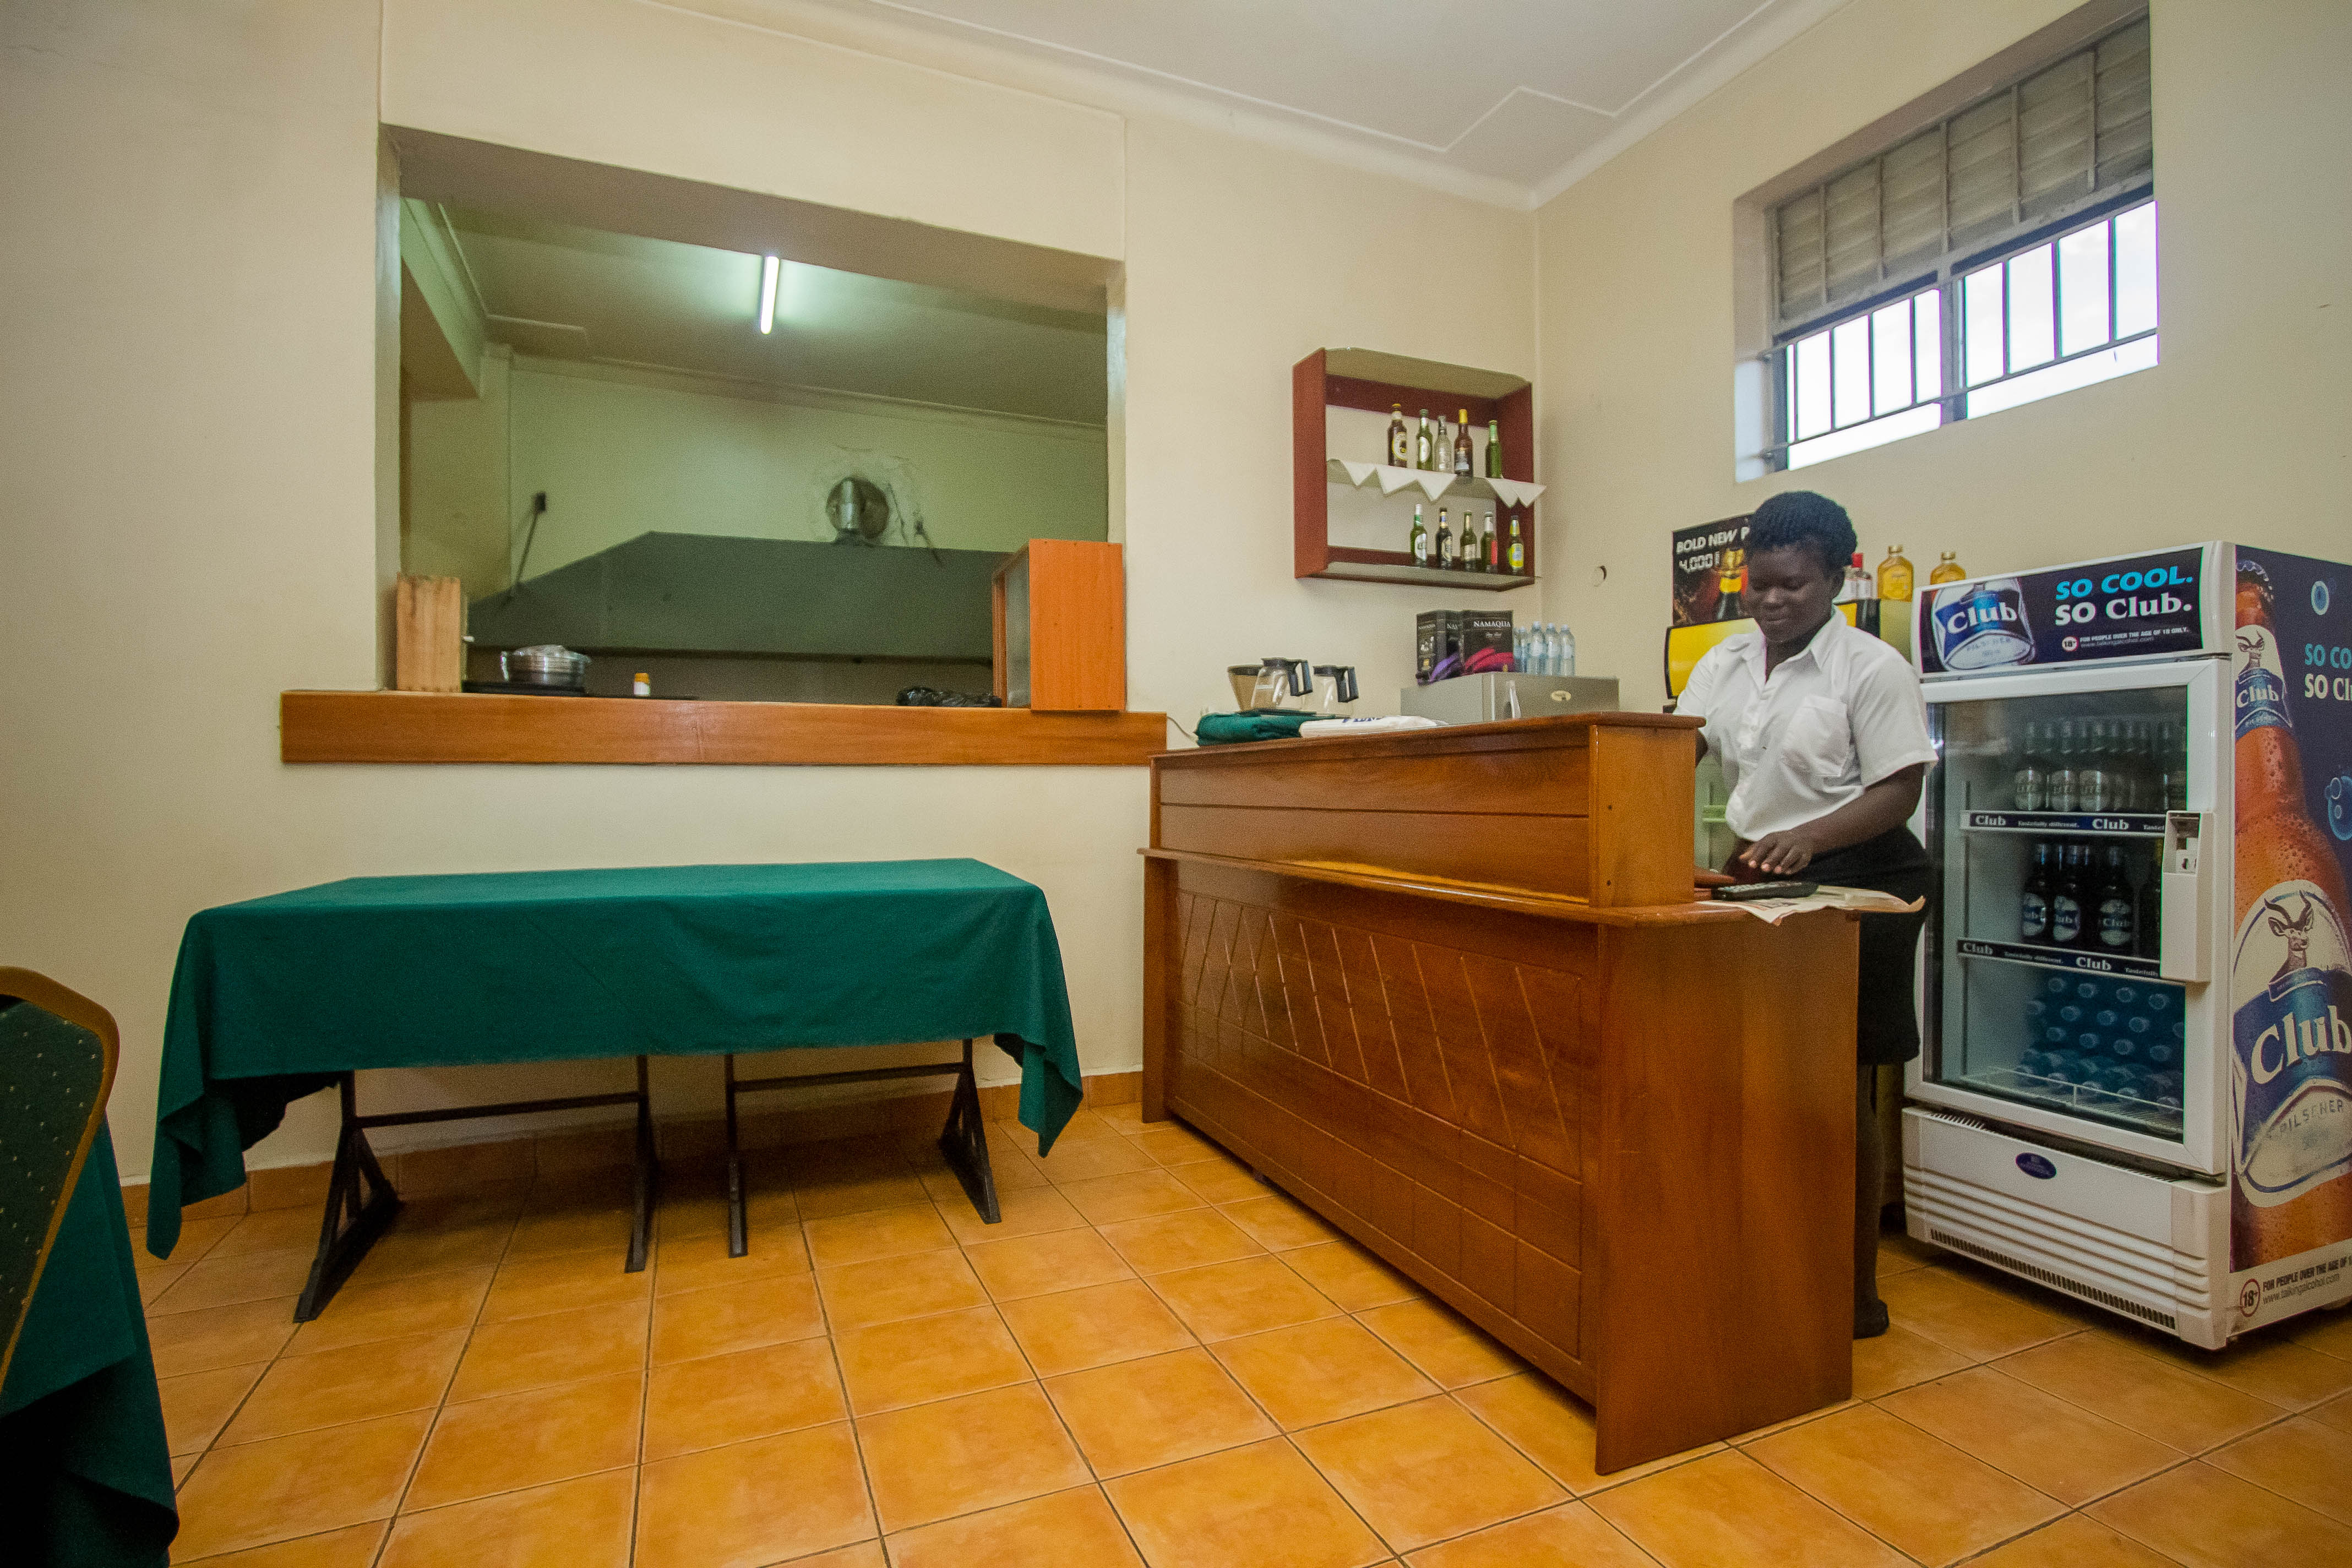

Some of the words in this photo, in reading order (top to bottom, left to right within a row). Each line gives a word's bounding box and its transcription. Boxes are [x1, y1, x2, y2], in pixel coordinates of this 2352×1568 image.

[1676, 536, 1706, 554] BOLD
[1708, 529, 1738, 546] NEW
[2056, 579, 2093, 600] SO
[2101, 566, 2193, 594] COOL.
[1947, 602, 2017, 633] Club
[2055, 602, 2097, 625] SO
[2105, 592, 2193, 619] Club.
[2305, 643, 2326, 666] SO
[2330, 646, 2352, 669] CO
[2236, 684, 2279, 708] Club
[2305, 673, 2328, 699] SO
[2333, 677, 2352, 701] Cl
[1975, 815, 2006, 826] Club
[2092, 818, 2130, 830] Club
[1963, 942, 1994, 956] Club
[2076, 957, 2112, 971] Club
[2251, 1005, 2352, 1084] Club
[2263, 1279, 2275, 1292] FOR
[2276, 1272, 2298, 1287] PEOPLE
[2300, 1267, 2315, 1281] OVER
[2316, 1263, 2327, 1275] THE
[2328, 1260, 2339, 1271] AGE
